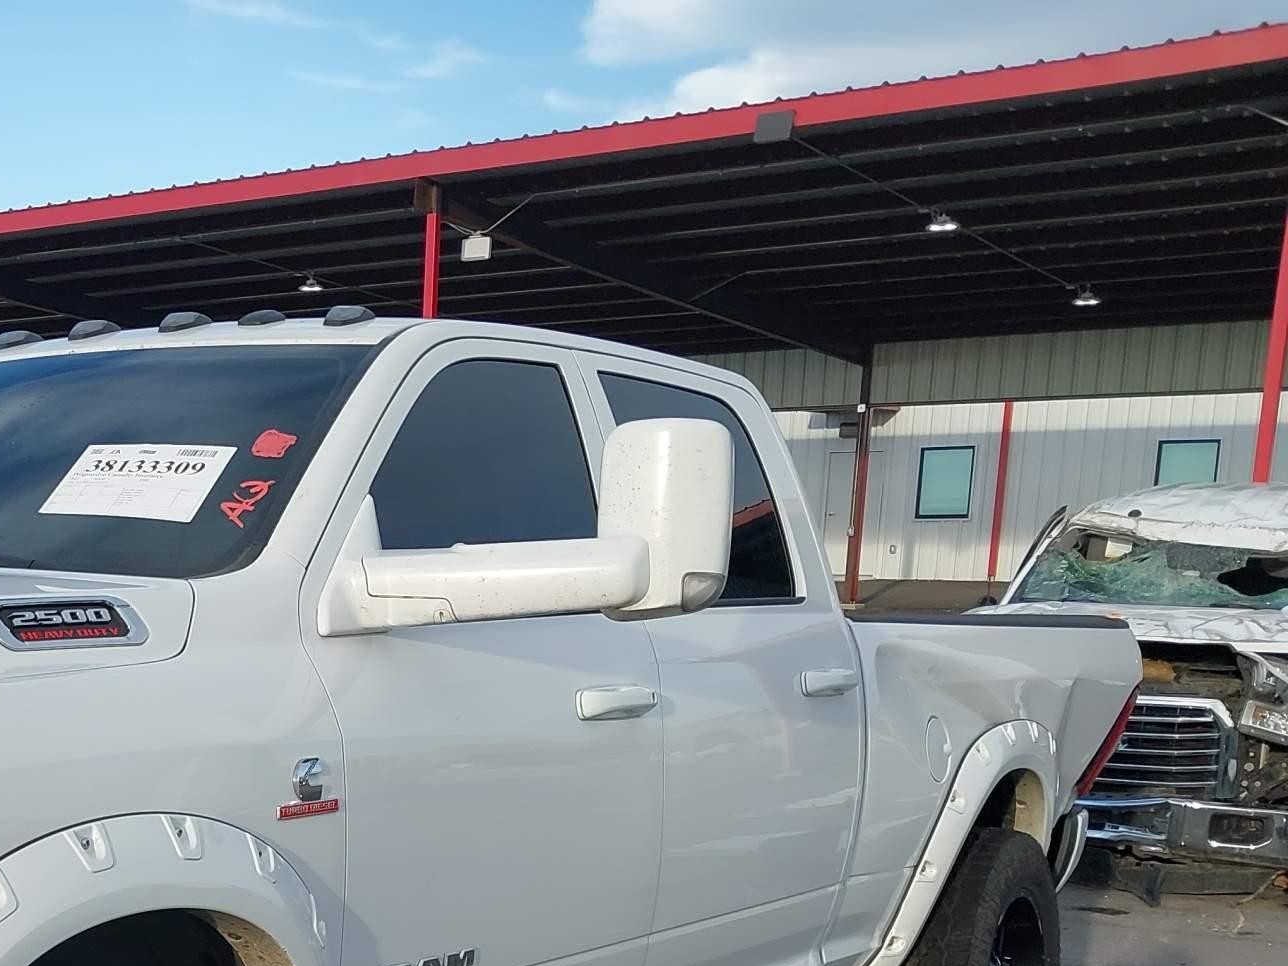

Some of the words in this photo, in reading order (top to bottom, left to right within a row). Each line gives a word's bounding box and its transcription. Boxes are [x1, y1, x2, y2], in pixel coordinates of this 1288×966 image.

[85, 459, 206, 476] 38133309
[8, 608, 112, 626] 2500
[20, 629, 73, 641] HEAVY
[75, 627, 120, 638] DUTY
[281, 804, 308, 817] TURBO
[309, 800, 336, 813] DIESEL
